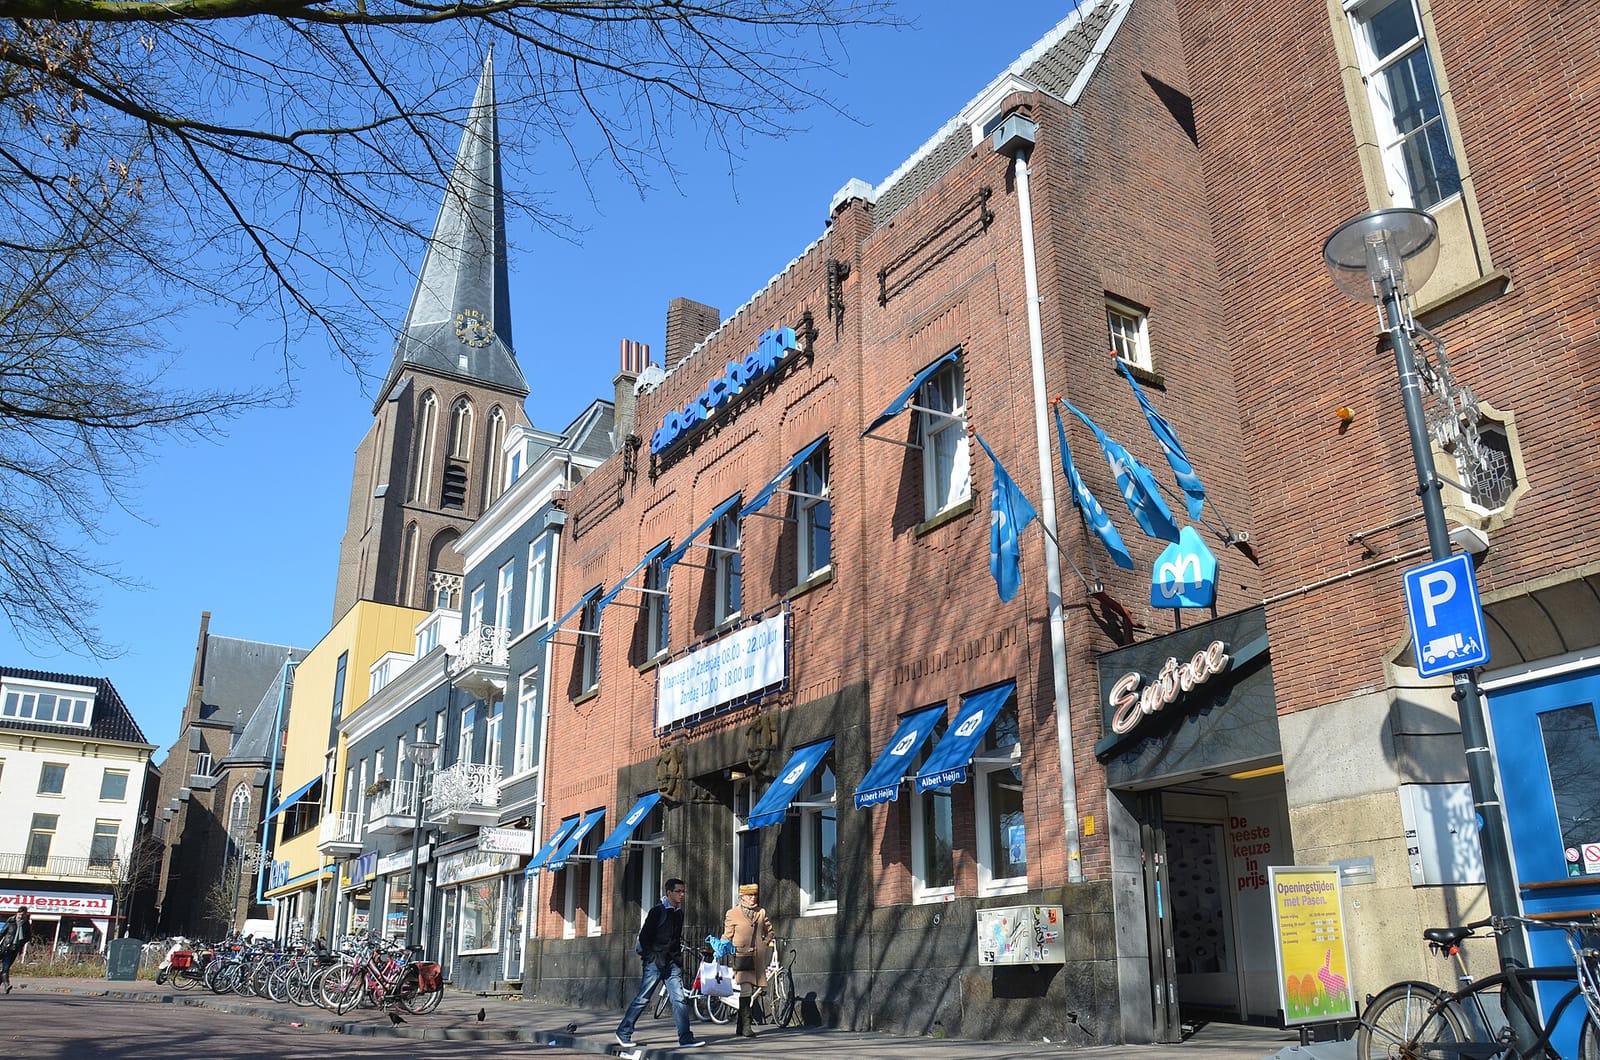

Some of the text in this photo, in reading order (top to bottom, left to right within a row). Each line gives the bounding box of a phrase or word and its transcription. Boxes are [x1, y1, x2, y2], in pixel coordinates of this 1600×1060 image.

[1419, 570, 1457, 628] P
[697, 654, 721, 676] Zaterdag
[747, 631, 767, 654] 22.00
[767, 628, 778, 645] uur
[680, 686, 700, 706] Zondag
[744, 664, 756, 680] uur
[1108, 639, 1230, 735] Entree
[921, 771, 961, 788] Albert Heijn
[860, 787, 894, 803] Albert Heijn
[1230, 816, 1247, 829] De
[1232, 842, 1271, 858] keuze
[1246, 857, 1258, 871] in
[1277, 880, 1335, 896] Openingstijden
[1283, 895, 1327, 908] met Pasen.
